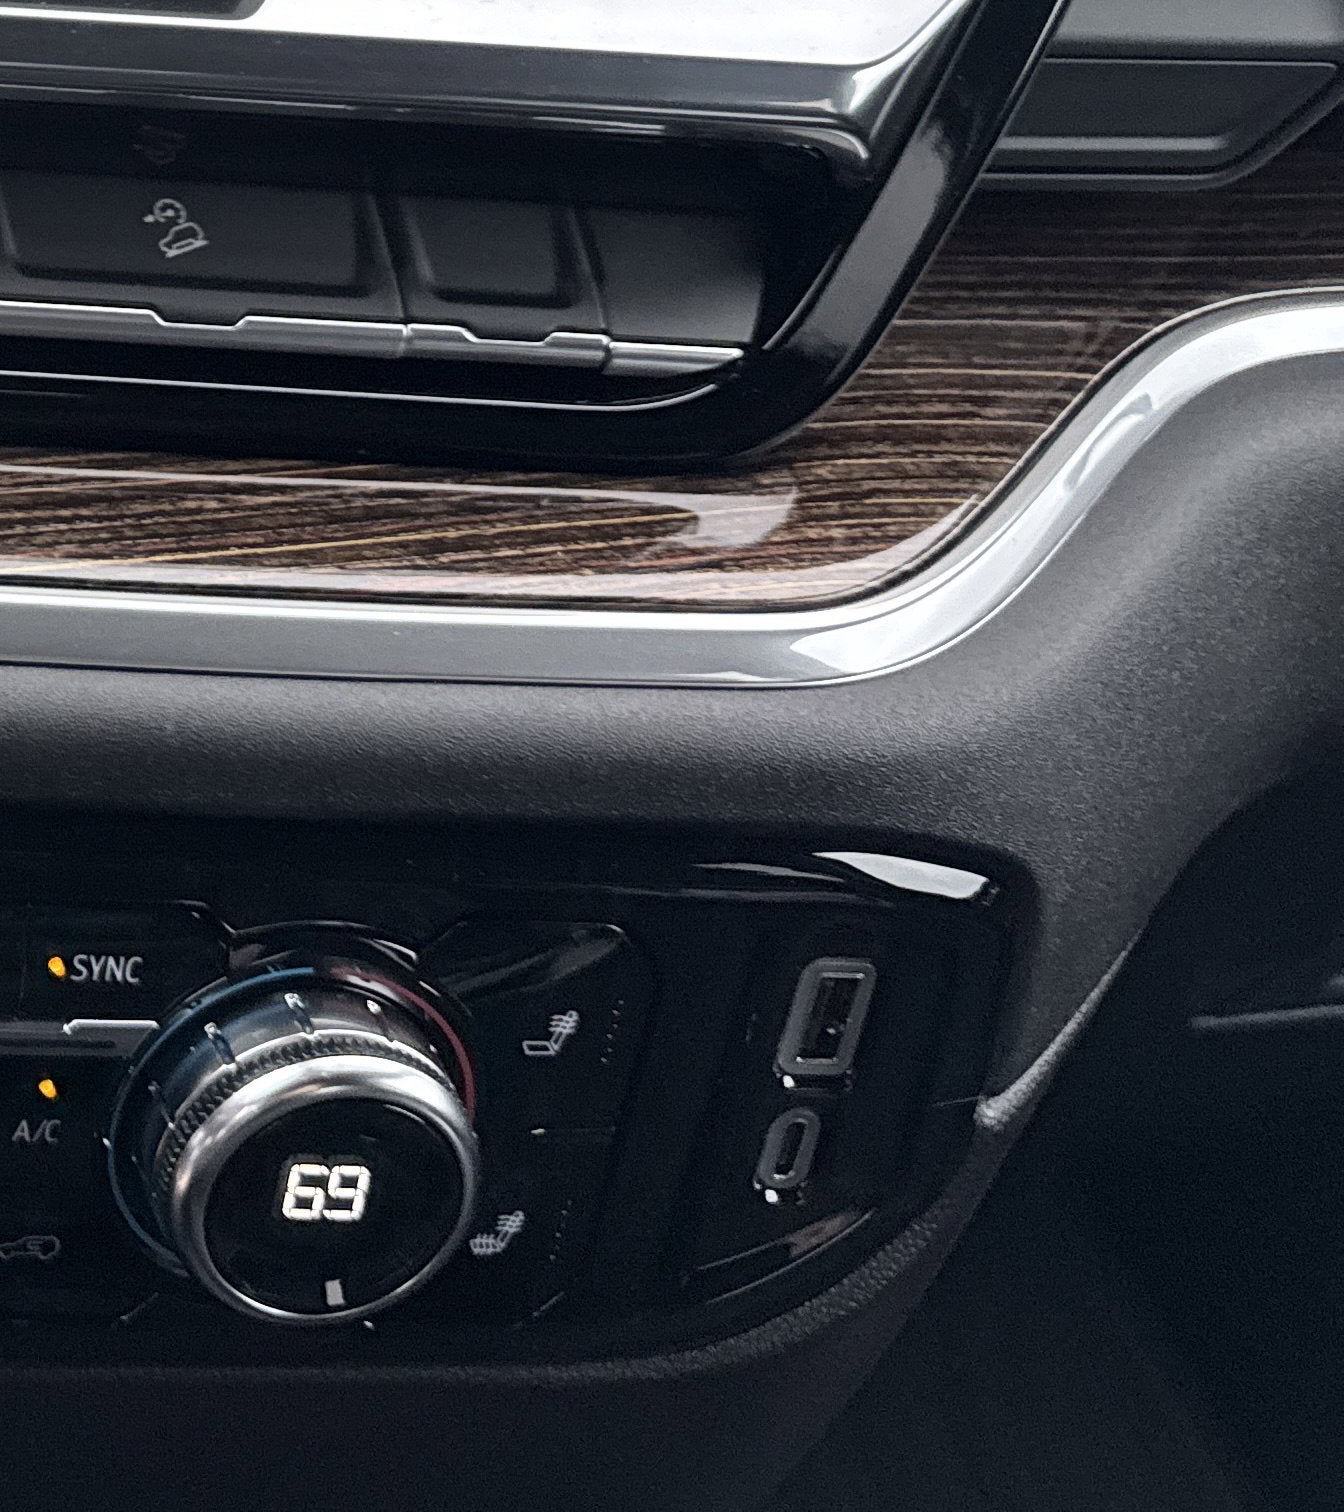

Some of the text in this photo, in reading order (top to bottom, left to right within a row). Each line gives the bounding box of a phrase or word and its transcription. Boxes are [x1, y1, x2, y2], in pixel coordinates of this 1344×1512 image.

[70, 954, 144, 984] SYNC
[12, 1118, 62, 1145] A/C
[281, 1161, 373, 1221] 69
